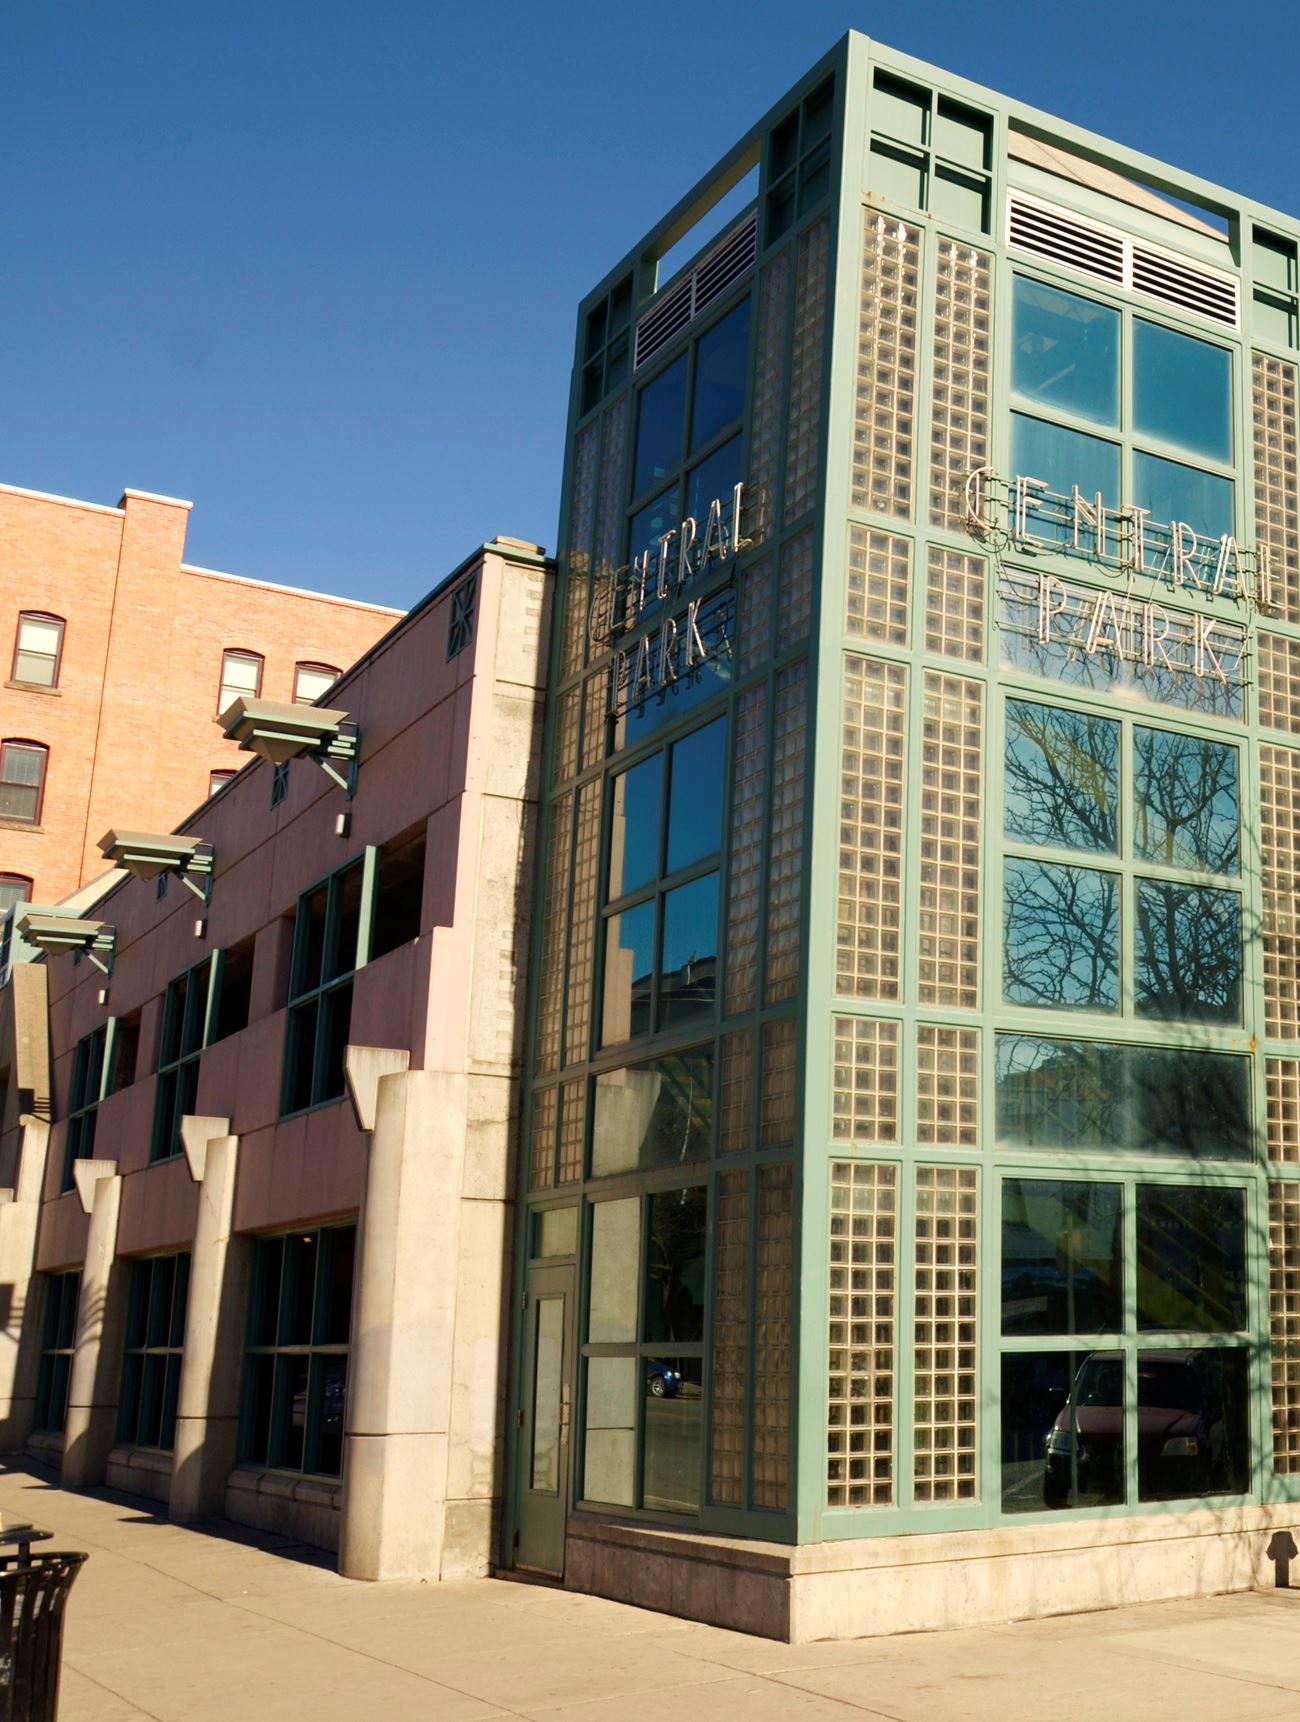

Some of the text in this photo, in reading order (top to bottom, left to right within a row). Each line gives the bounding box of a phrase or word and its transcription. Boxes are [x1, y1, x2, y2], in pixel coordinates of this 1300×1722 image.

[588, 482, 753, 642] CENTRAL
[965, 466, 1283, 609] CENTRAL
[606, 597, 707, 715] PARK
[1038, 573, 1229, 685] PARK
